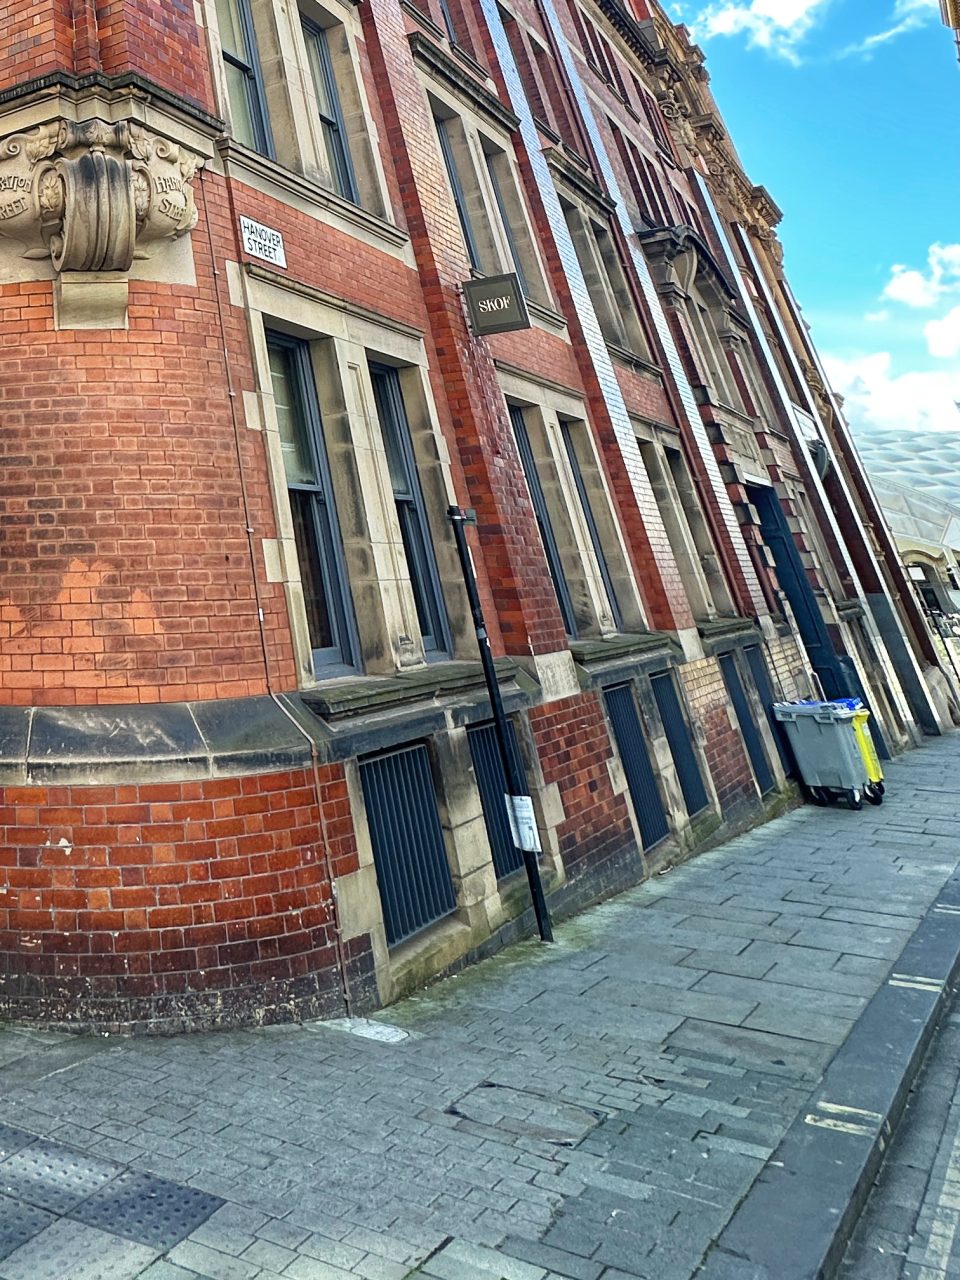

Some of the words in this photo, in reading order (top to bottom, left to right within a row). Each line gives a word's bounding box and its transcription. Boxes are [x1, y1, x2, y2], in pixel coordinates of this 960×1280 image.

[243, 220, 282, 248] HANOVER
[247, 237, 277, 261] STREET
[478, 296, 511, 313] SKOF
